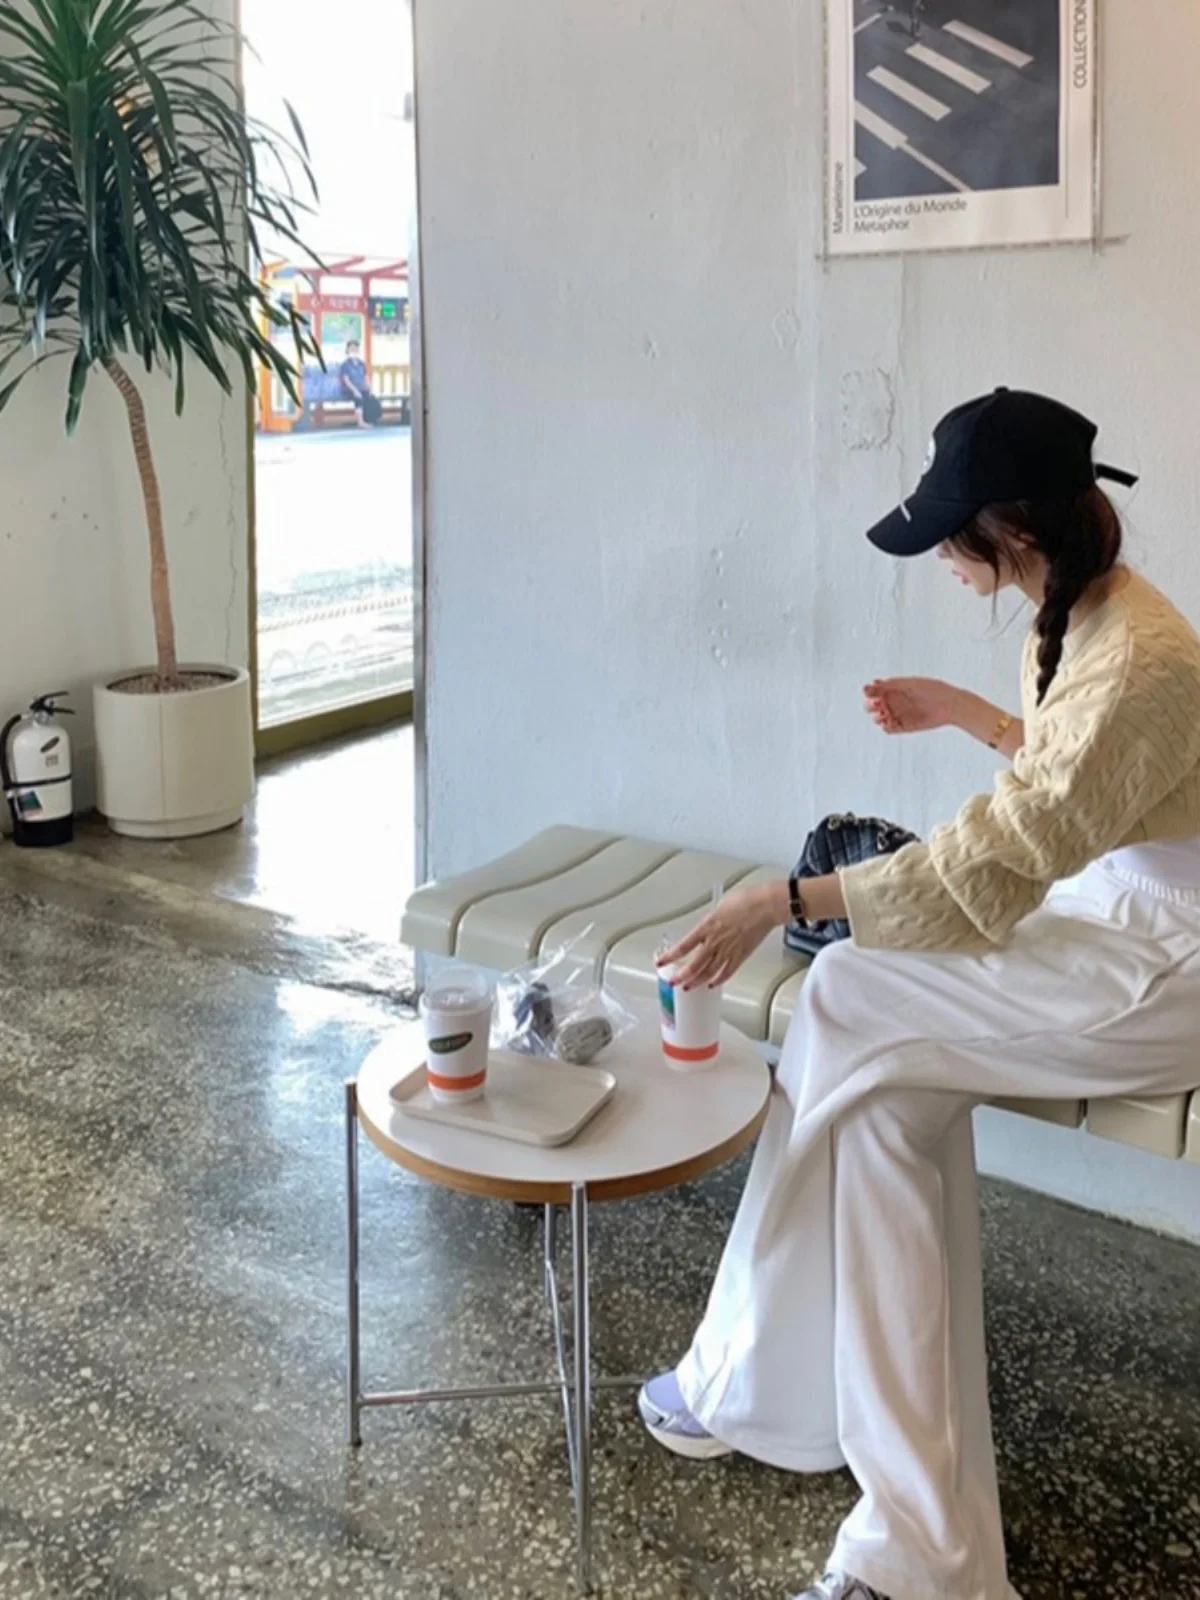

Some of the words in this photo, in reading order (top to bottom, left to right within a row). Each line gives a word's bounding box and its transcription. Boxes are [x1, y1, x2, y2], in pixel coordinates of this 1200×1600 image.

[1073, 0, 1087, 89] COLLECTION
[904, 200, 921, 214] du
[923, 198, 967, 213] Monde
